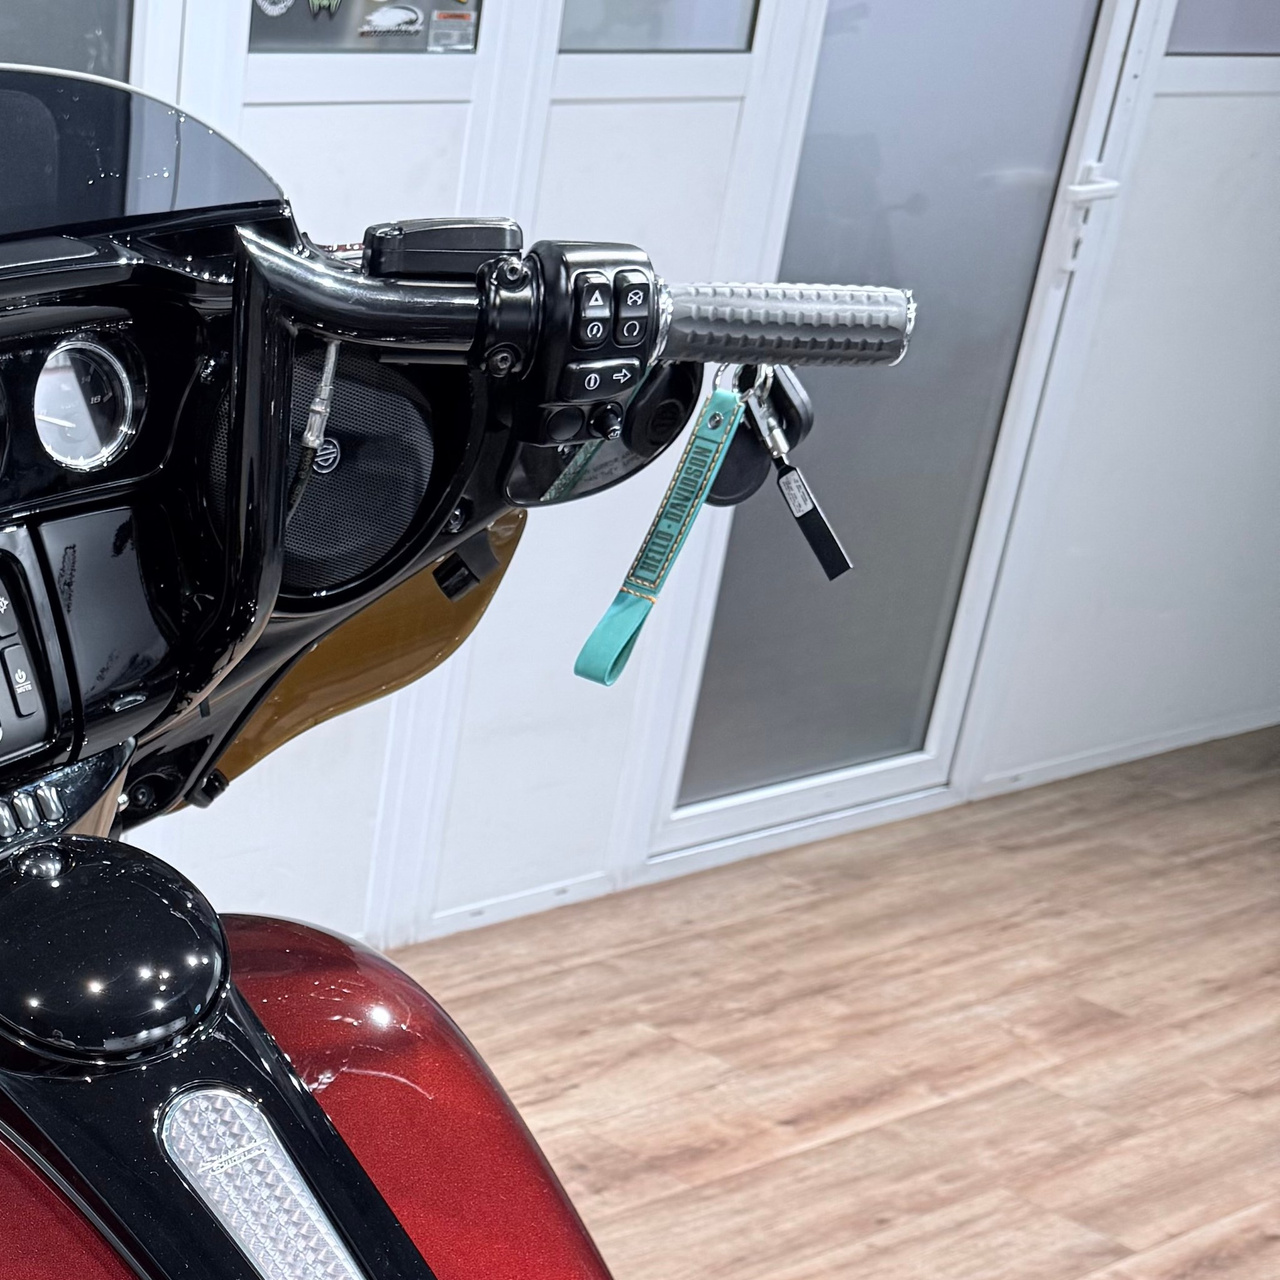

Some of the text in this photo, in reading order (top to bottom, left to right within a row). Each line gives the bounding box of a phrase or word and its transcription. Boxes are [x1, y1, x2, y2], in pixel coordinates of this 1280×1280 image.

[90, 395, 101, 405] 16
[639, 445, 713, 575] HELLO DAVIDSON
